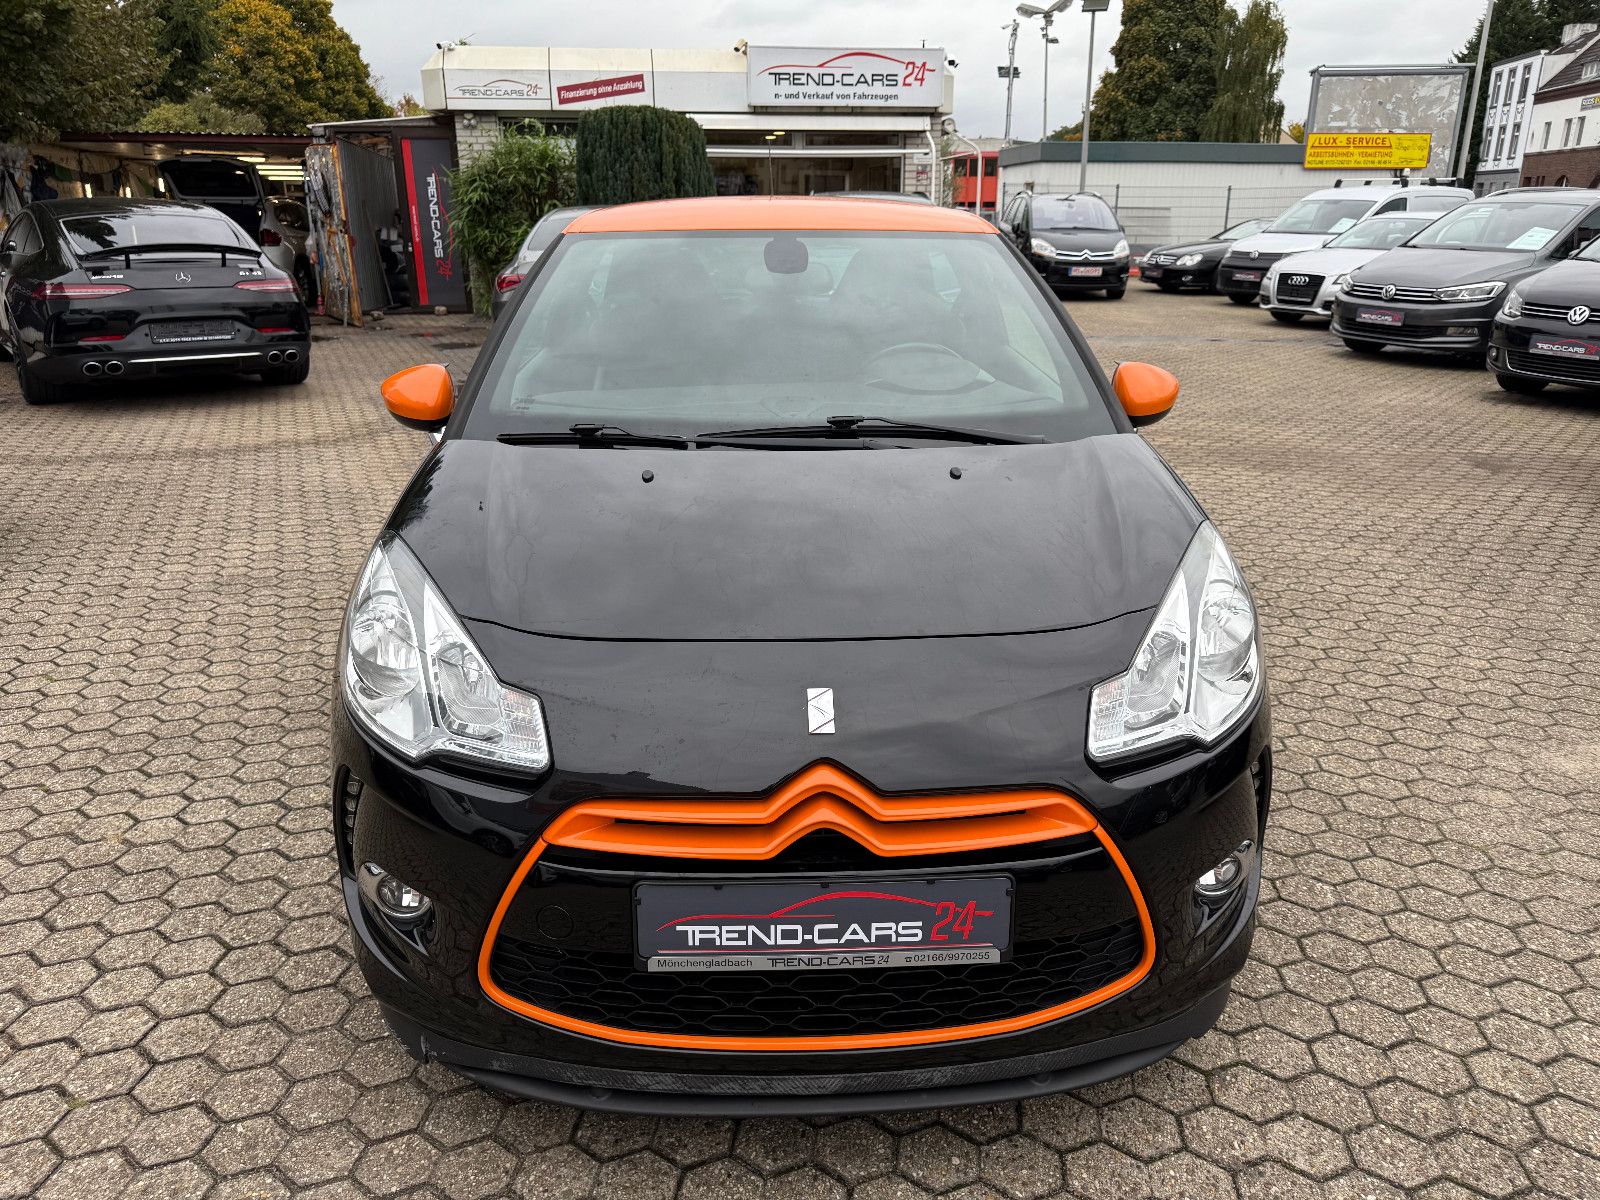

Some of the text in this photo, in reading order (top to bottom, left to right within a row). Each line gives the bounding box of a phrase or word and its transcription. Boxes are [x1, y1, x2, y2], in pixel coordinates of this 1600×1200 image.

[768, 61, 929, 87] TREND-CARS 24
[458, 84, 540, 97] TREND-CARS 24
[560, 80, 643, 99] Finanzierung ohne Anzahlung
[785, 91, 800, 99] und
[802, 91, 834, 100] Verkauf
[853, 91, 898, 102] Fahrzeugen
[1318, 136, 1338, 145] LUX
[1345, 136, 1388, 145] SERVICE
[426, 173, 444, 258] TREND-CARS
[1536, 342, 1586, 354] TREND-CARS
[675, 900, 979, 946] TREND-CARS 24
[656, 950, 991, 970] Mönchengladbach TREND-CARS 24 02166/9970255
